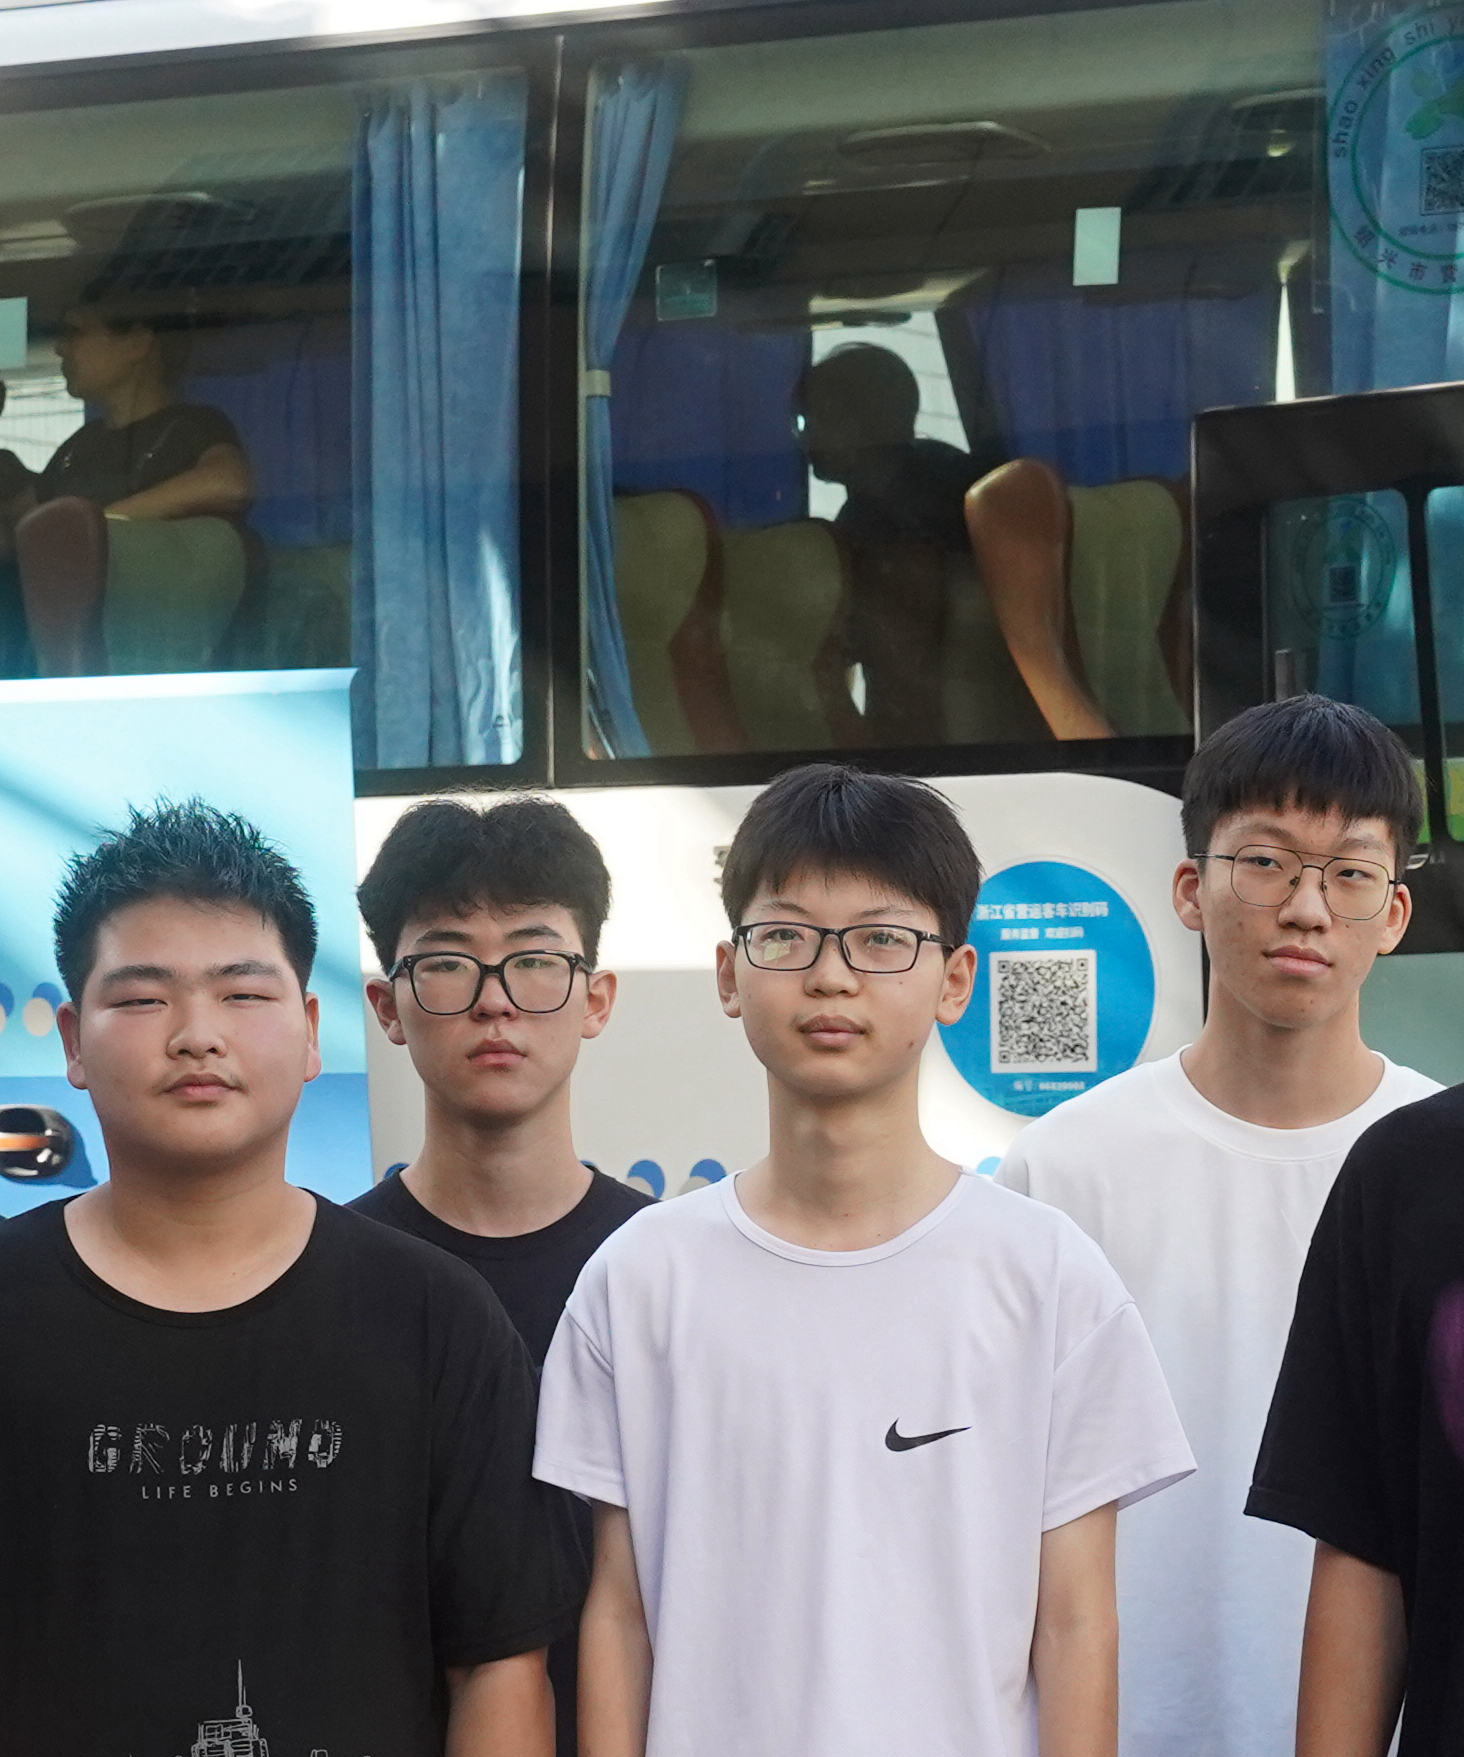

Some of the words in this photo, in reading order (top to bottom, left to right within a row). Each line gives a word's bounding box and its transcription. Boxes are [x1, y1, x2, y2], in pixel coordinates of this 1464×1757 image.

[88, 1417, 345, 1475] GROUND
[141, 1485, 193, 1500] LIFE
[209, 1478, 299, 1498] BEGINS
